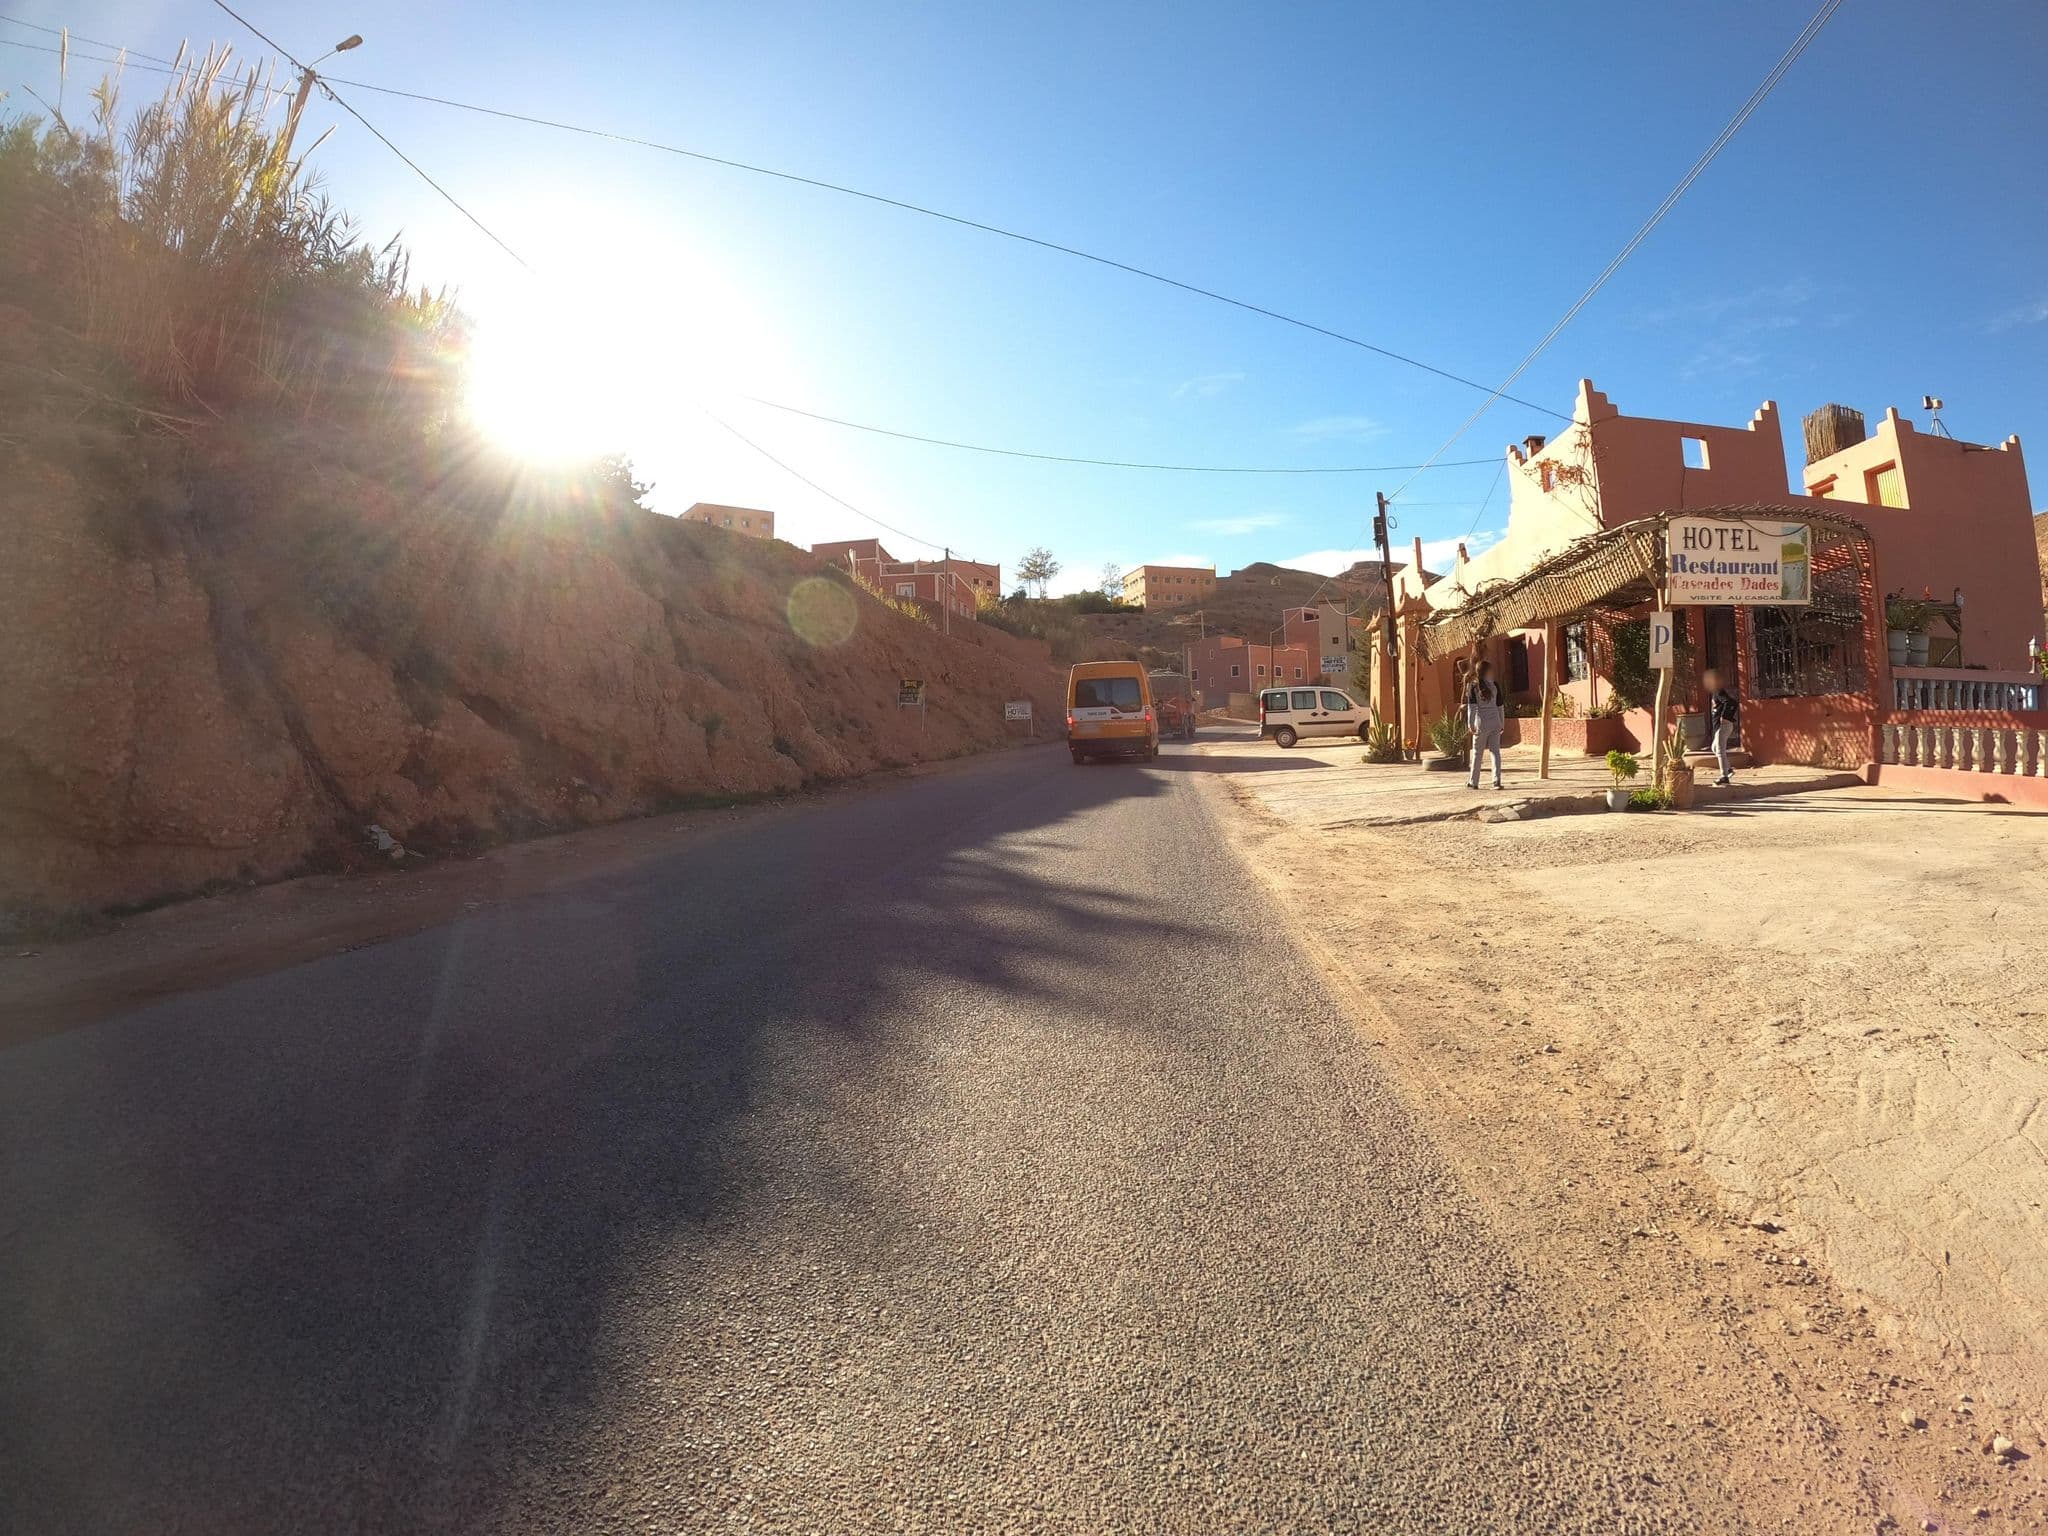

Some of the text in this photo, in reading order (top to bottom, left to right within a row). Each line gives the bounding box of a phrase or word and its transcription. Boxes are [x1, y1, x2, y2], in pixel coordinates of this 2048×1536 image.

[1683, 527, 1759, 551] HOTEL
[1672, 553, 1778, 575] Restaurant
[1671, 576, 1779, 591] Cascades Dades
[1654, 625, 1670, 654] P
